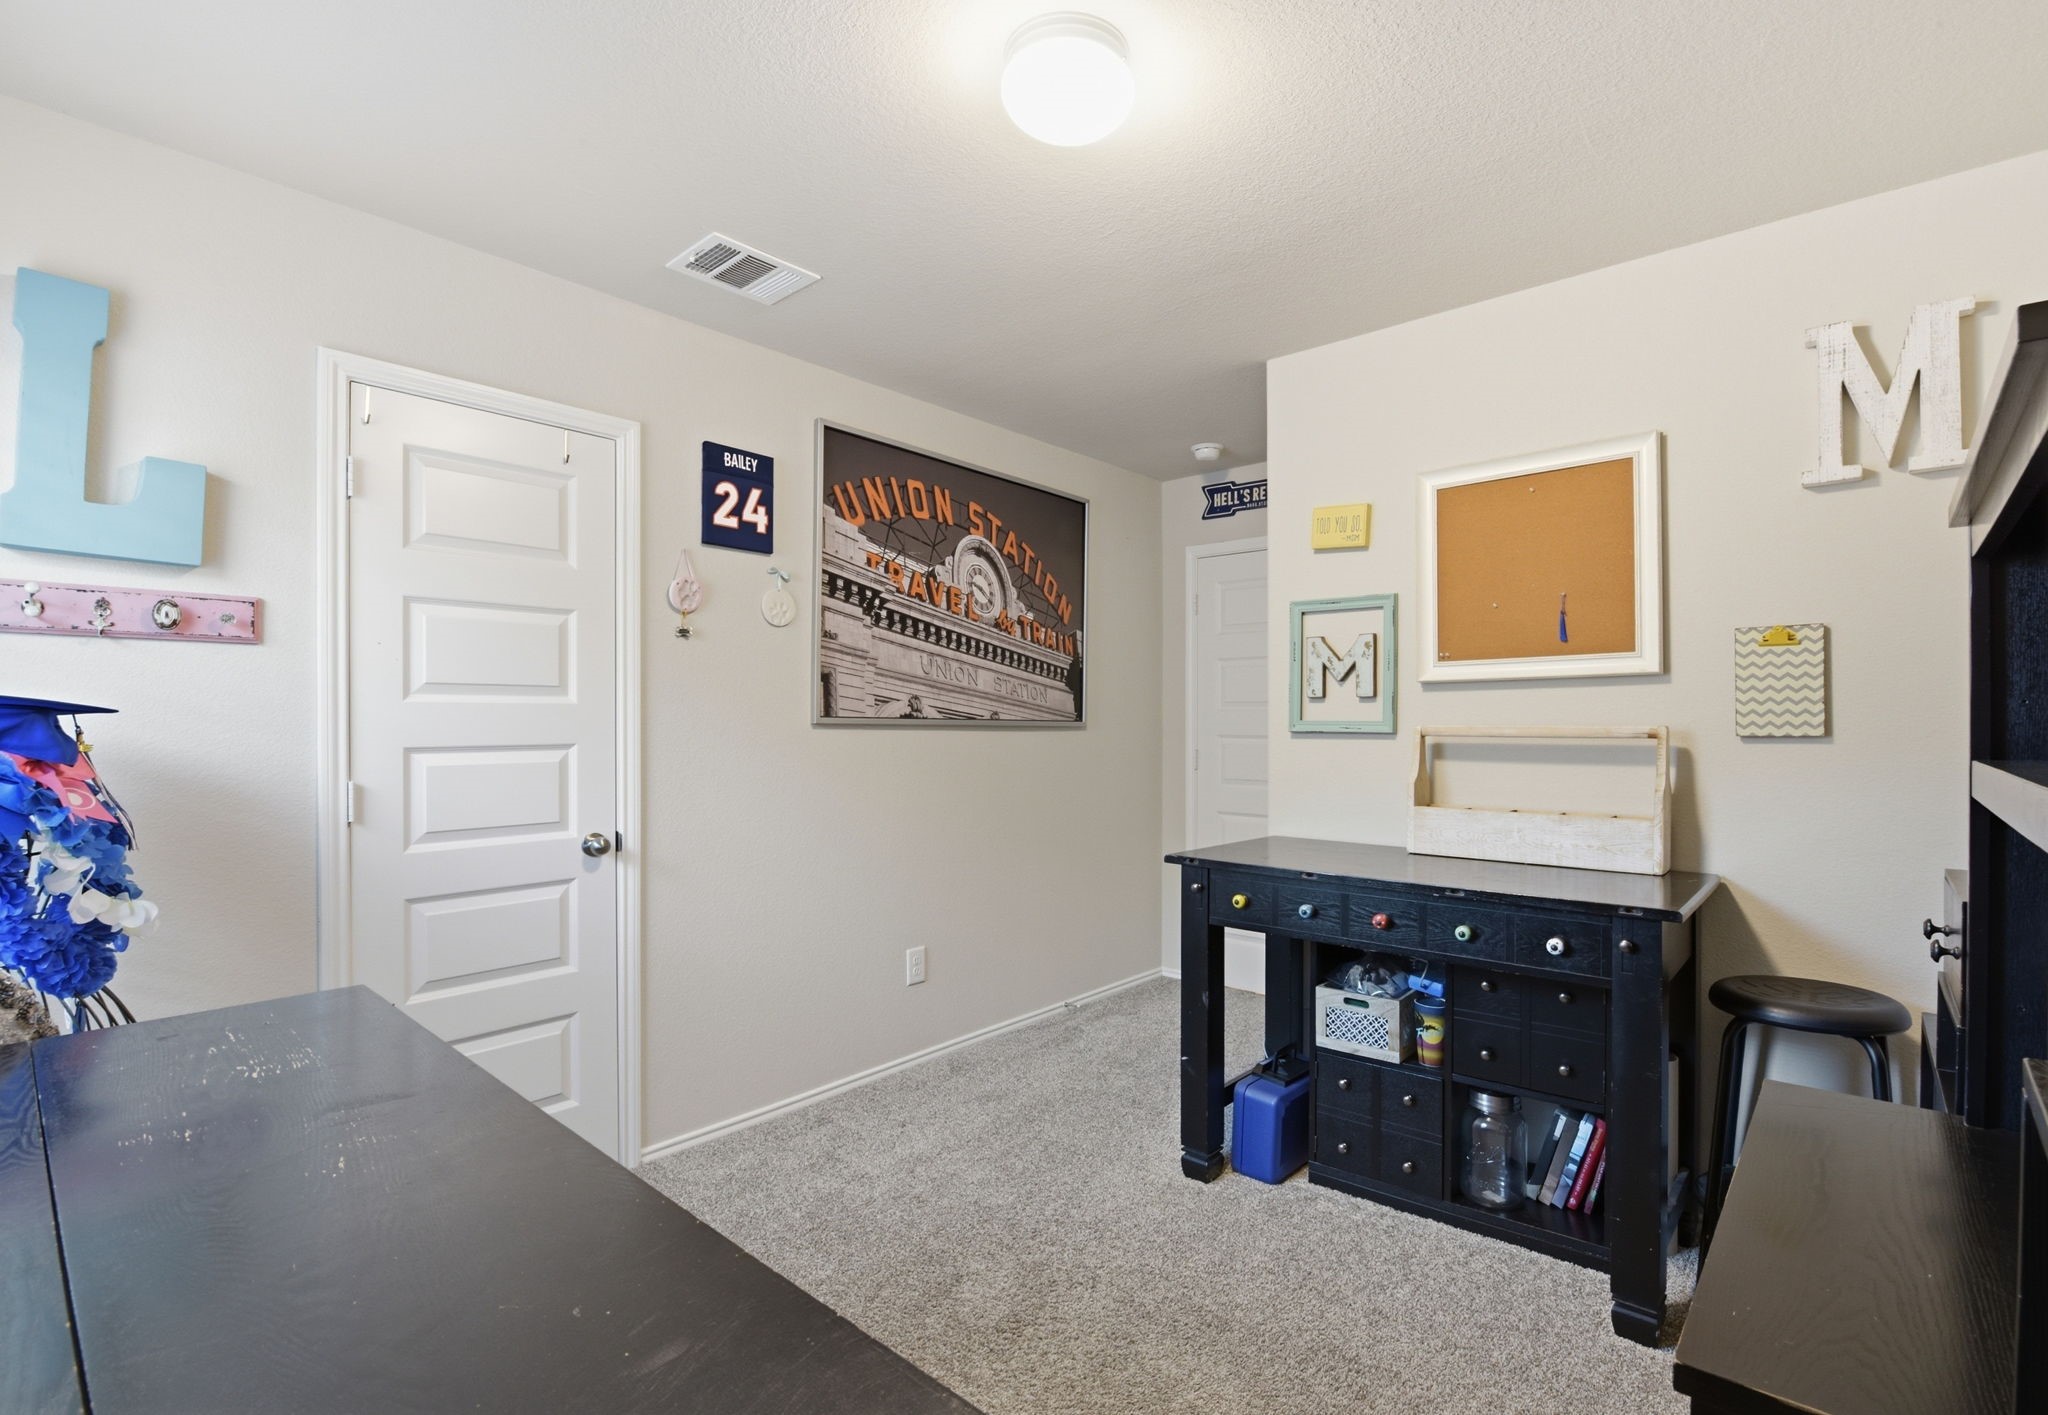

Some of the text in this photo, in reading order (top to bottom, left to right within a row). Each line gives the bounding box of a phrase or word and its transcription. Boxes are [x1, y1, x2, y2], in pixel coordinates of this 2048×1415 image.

[724, 452, 758, 472] BAILEY
[712, 480, 769, 535] 24
[1213, 488, 1251, 507] HELL'S
[1334, 515, 1348, 533] YOU
[832, 476, 1073, 626] UNION STATION
[865, 551, 980, 622] TRAVEL
[1018, 614, 1074, 657] TRAIN
[919, 655, 1049, 705] UNION STATION
[1306, 633, 1377, 699] M
